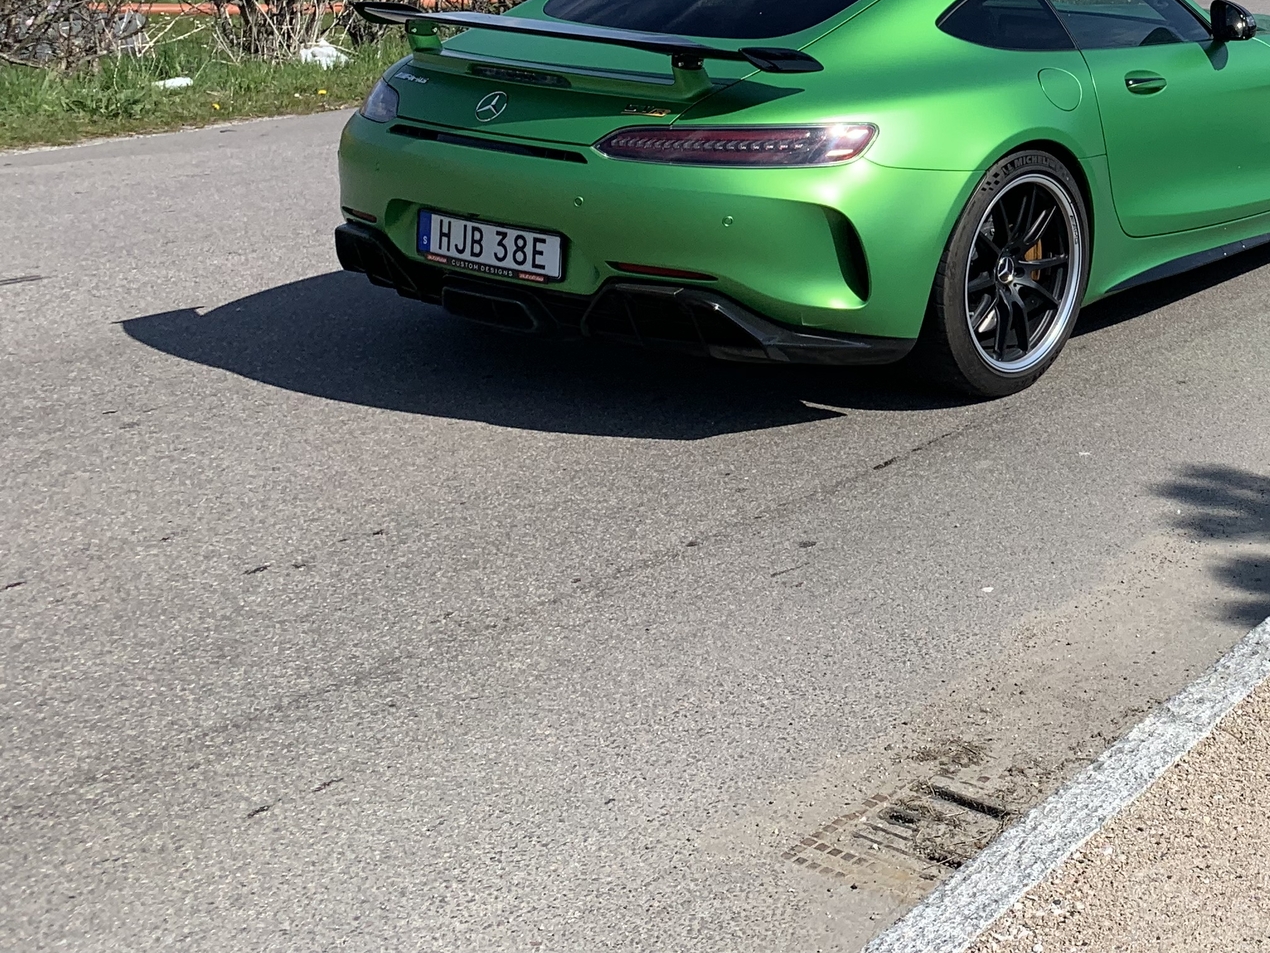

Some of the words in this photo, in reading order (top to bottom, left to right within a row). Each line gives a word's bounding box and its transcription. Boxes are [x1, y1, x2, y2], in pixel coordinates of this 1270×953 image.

[422, 235, 428, 245] S
[438, 219, 484, 258] HJB
[493, 230, 547, 271] 38E
[451, 259, 479, 271] CUSTOM
[480, 266, 513, 277] DESIGNS
